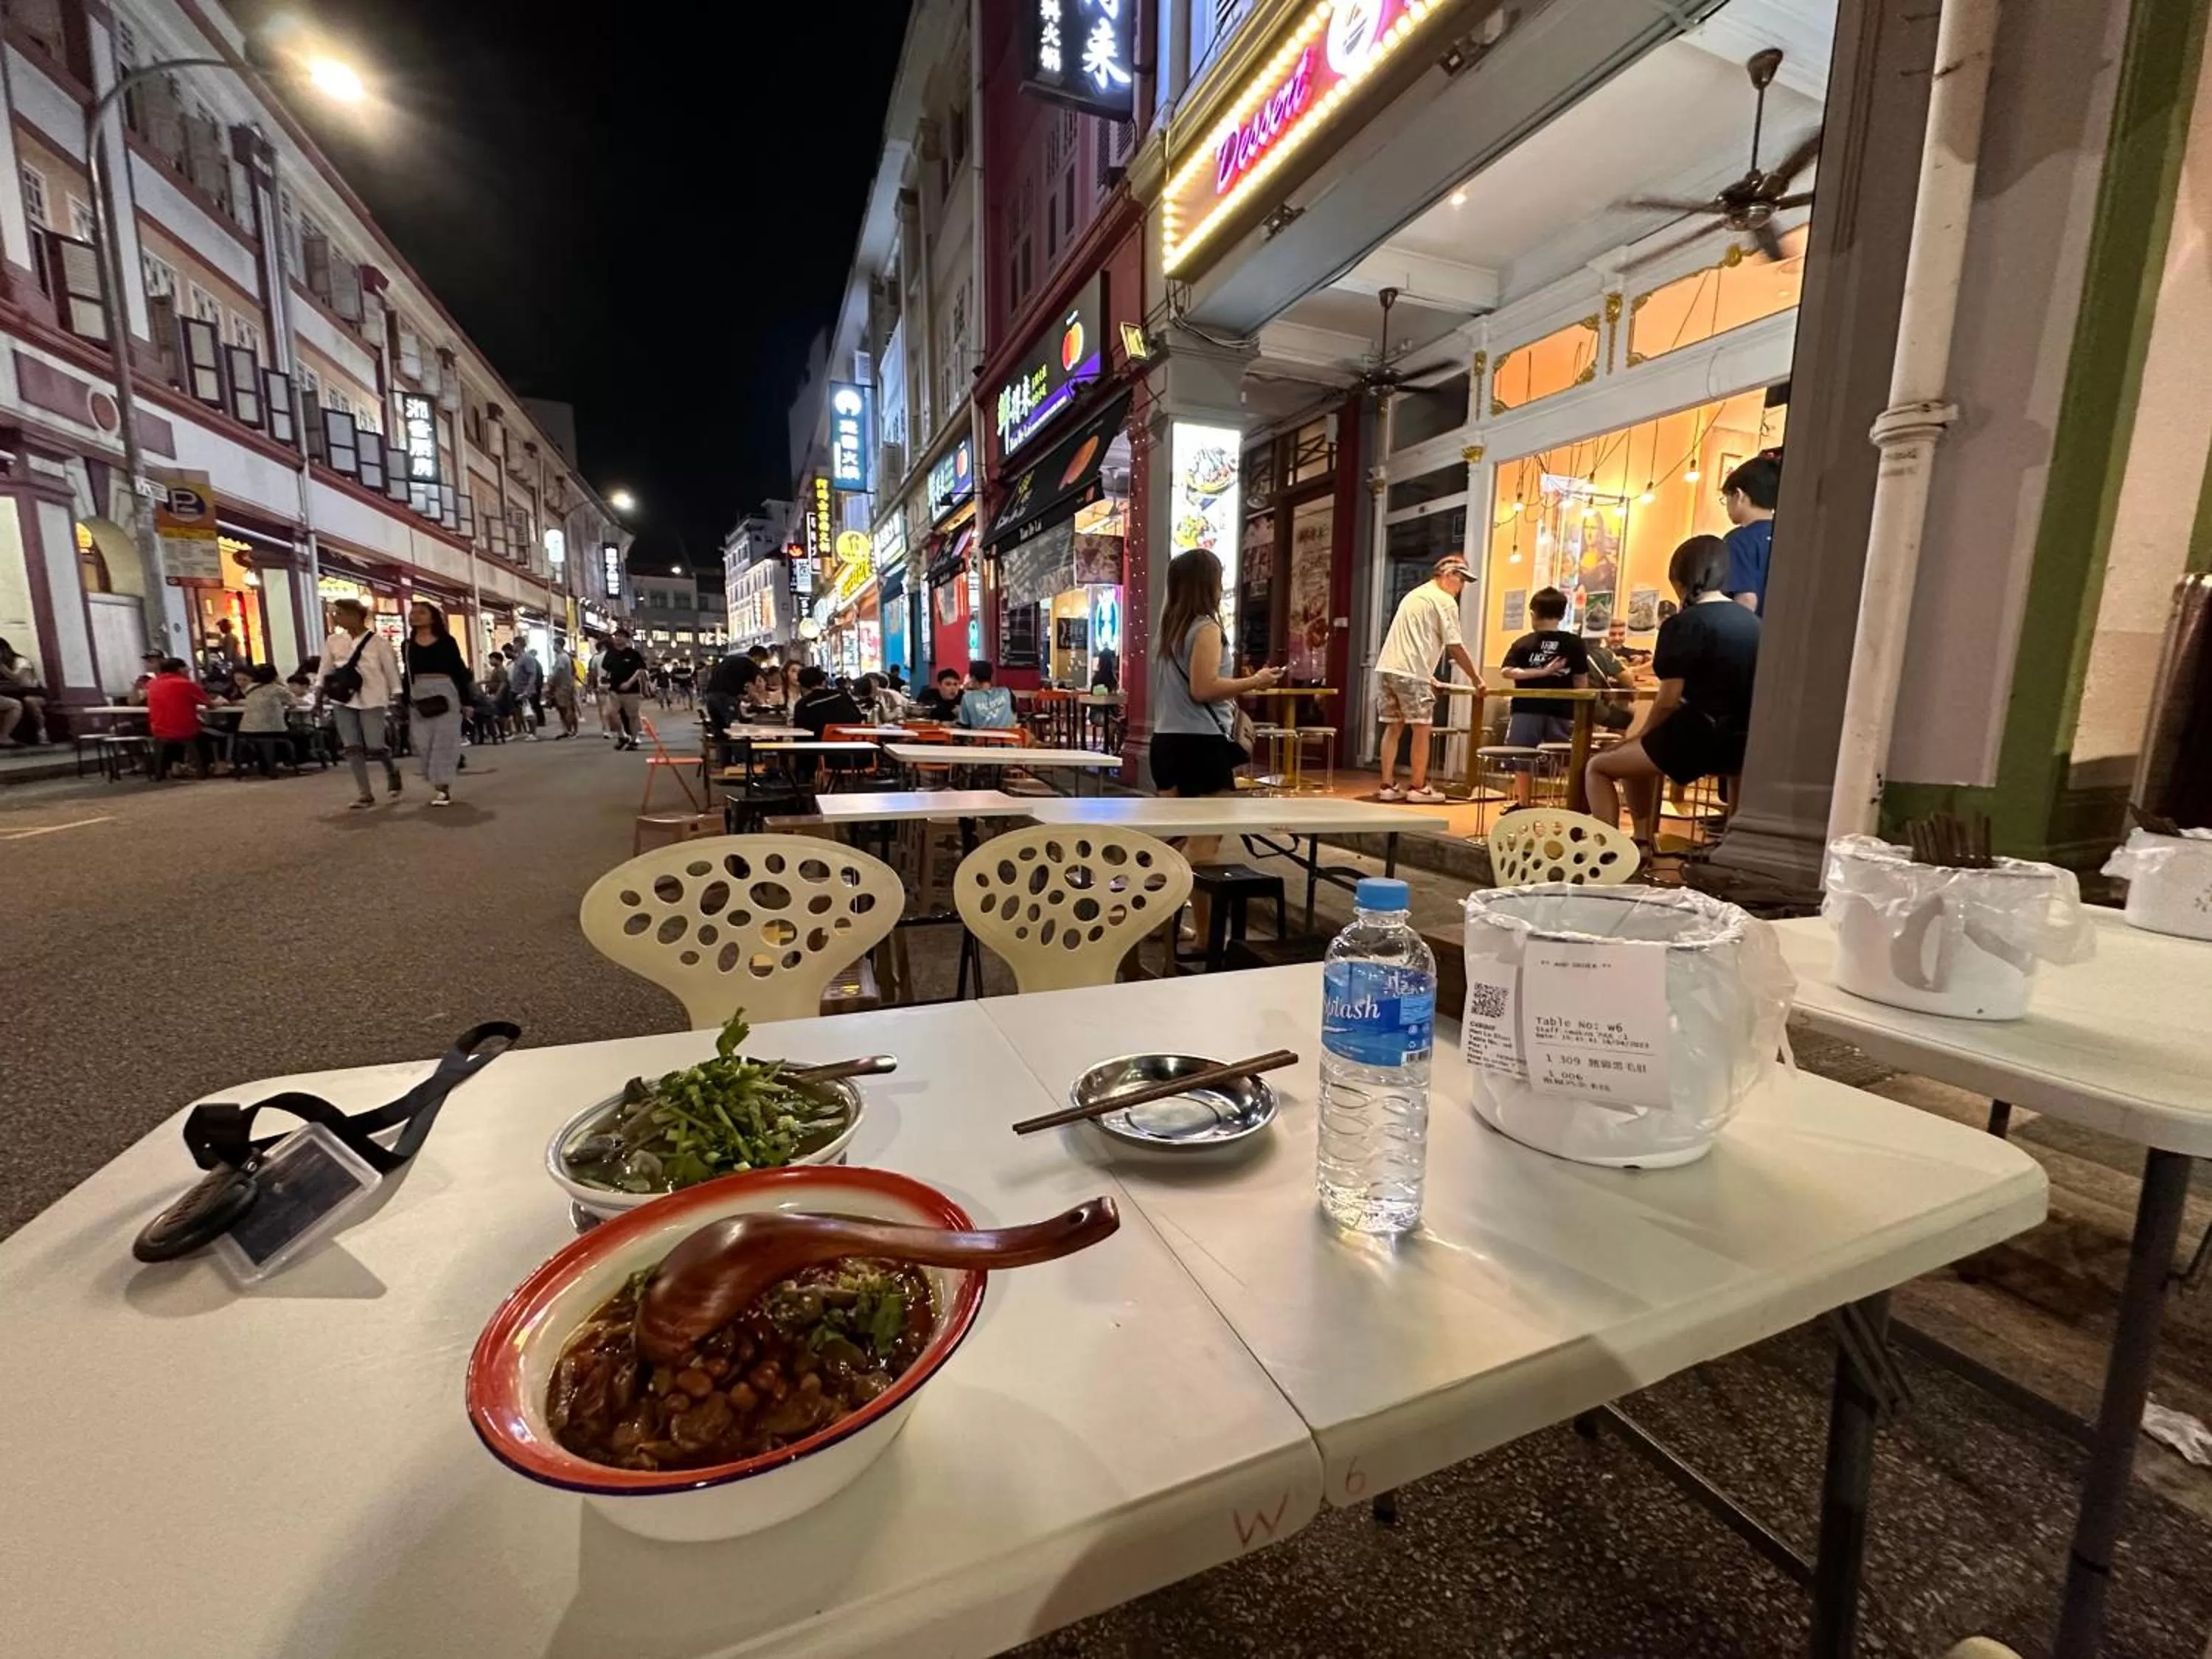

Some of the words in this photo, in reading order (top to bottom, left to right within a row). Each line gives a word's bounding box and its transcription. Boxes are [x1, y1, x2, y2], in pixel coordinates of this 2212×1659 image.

[1216, 46, 1312, 195] Dessert
[1536, 1016, 1571, 1028] Table
[1606, 1022, 1624, 1033] w6
[1231, 1486, 1290, 1550] W
[1343, 1455, 1367, 1496] 6
